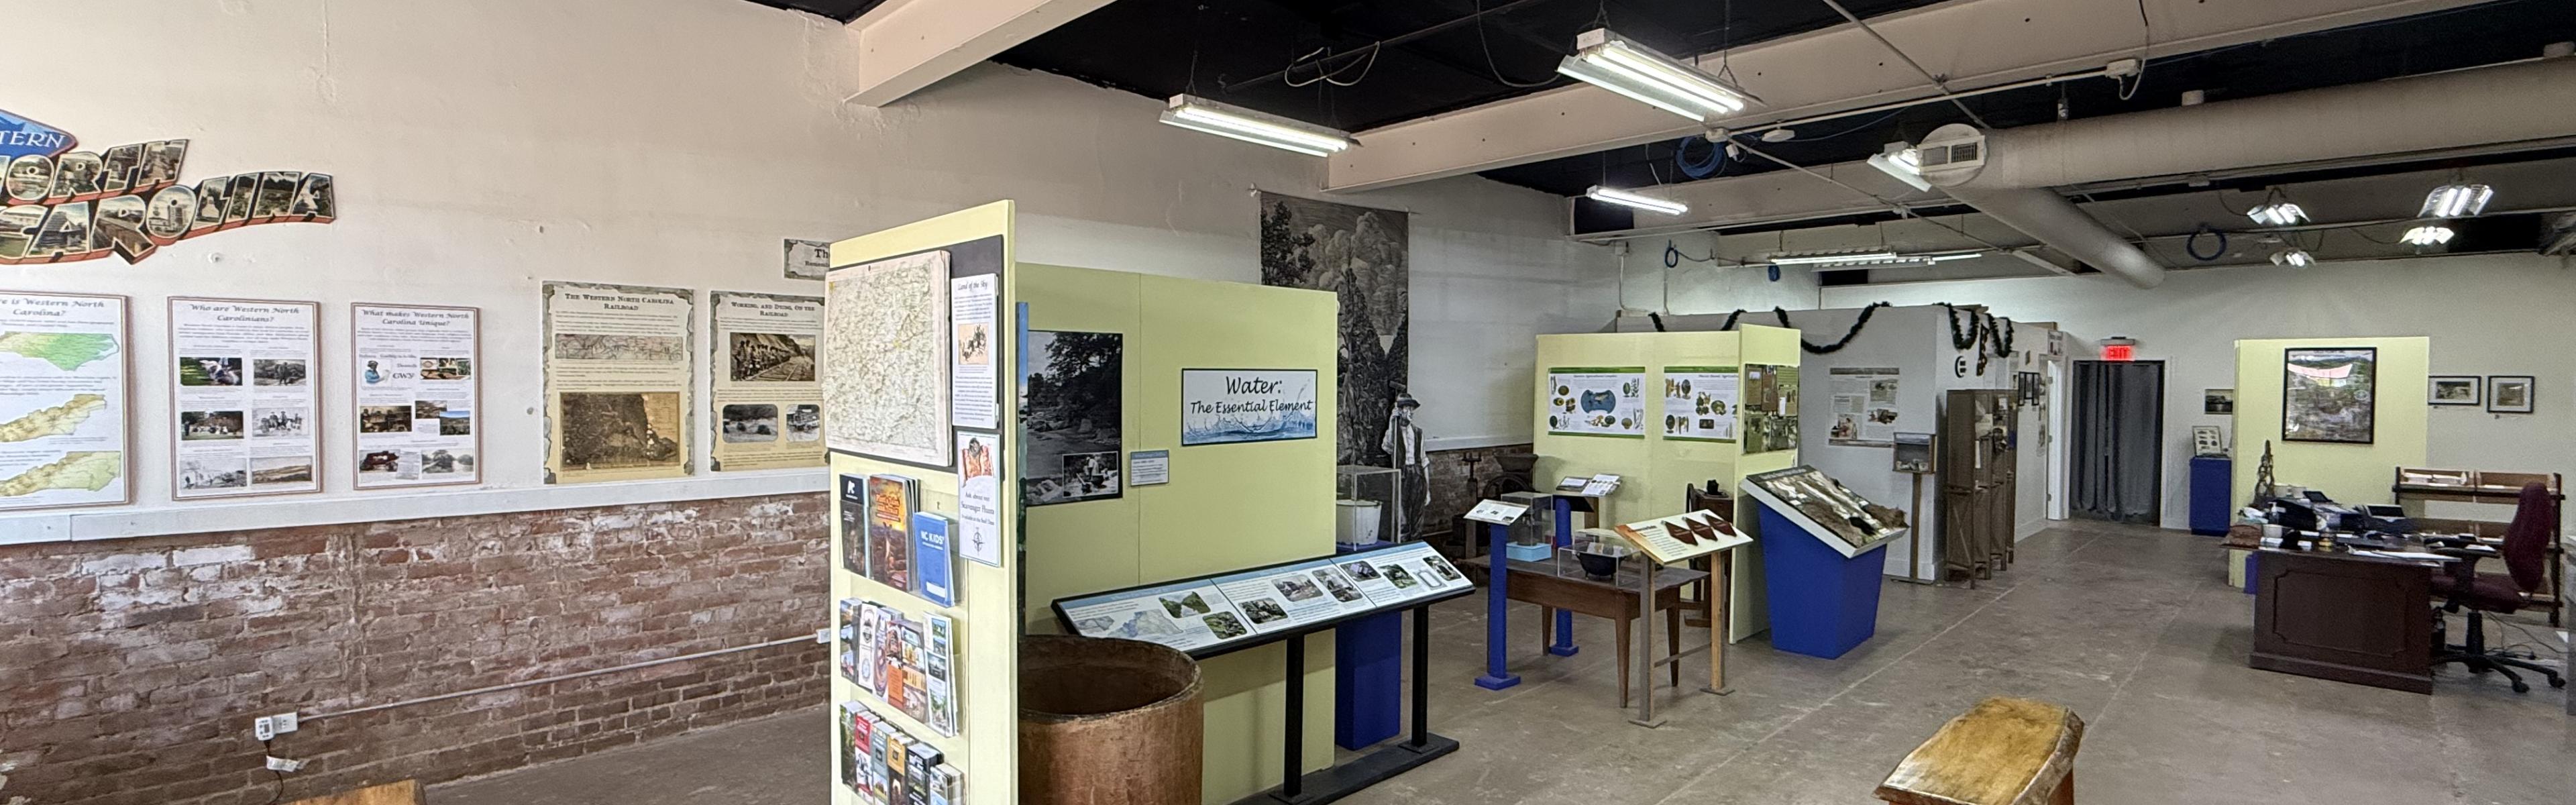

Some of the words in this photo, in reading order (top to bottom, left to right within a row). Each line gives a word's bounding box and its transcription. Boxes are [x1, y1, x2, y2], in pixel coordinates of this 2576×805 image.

[958, 282, 967, 290] Land
[969, 282, 973, 291] of
[582, 294, 615, 302] WESTERN
[25, 297, 68, 307] Western
[71, 300, 105, 308] North
[13, 309, 66, 317] Carolina?
[231, 305, 269, 313] Western
[413, 311, 444, 319] Western
[419, 319, 450, 327] Unique?
[2108, 347, 2129, 359] EXIT
[1226, 376, 1283, 395] Water:
[1191, 400, 1214, 414] The
[1216, 399, 1268, 413] Essential
[1269, 400, 1313, 413] Element
